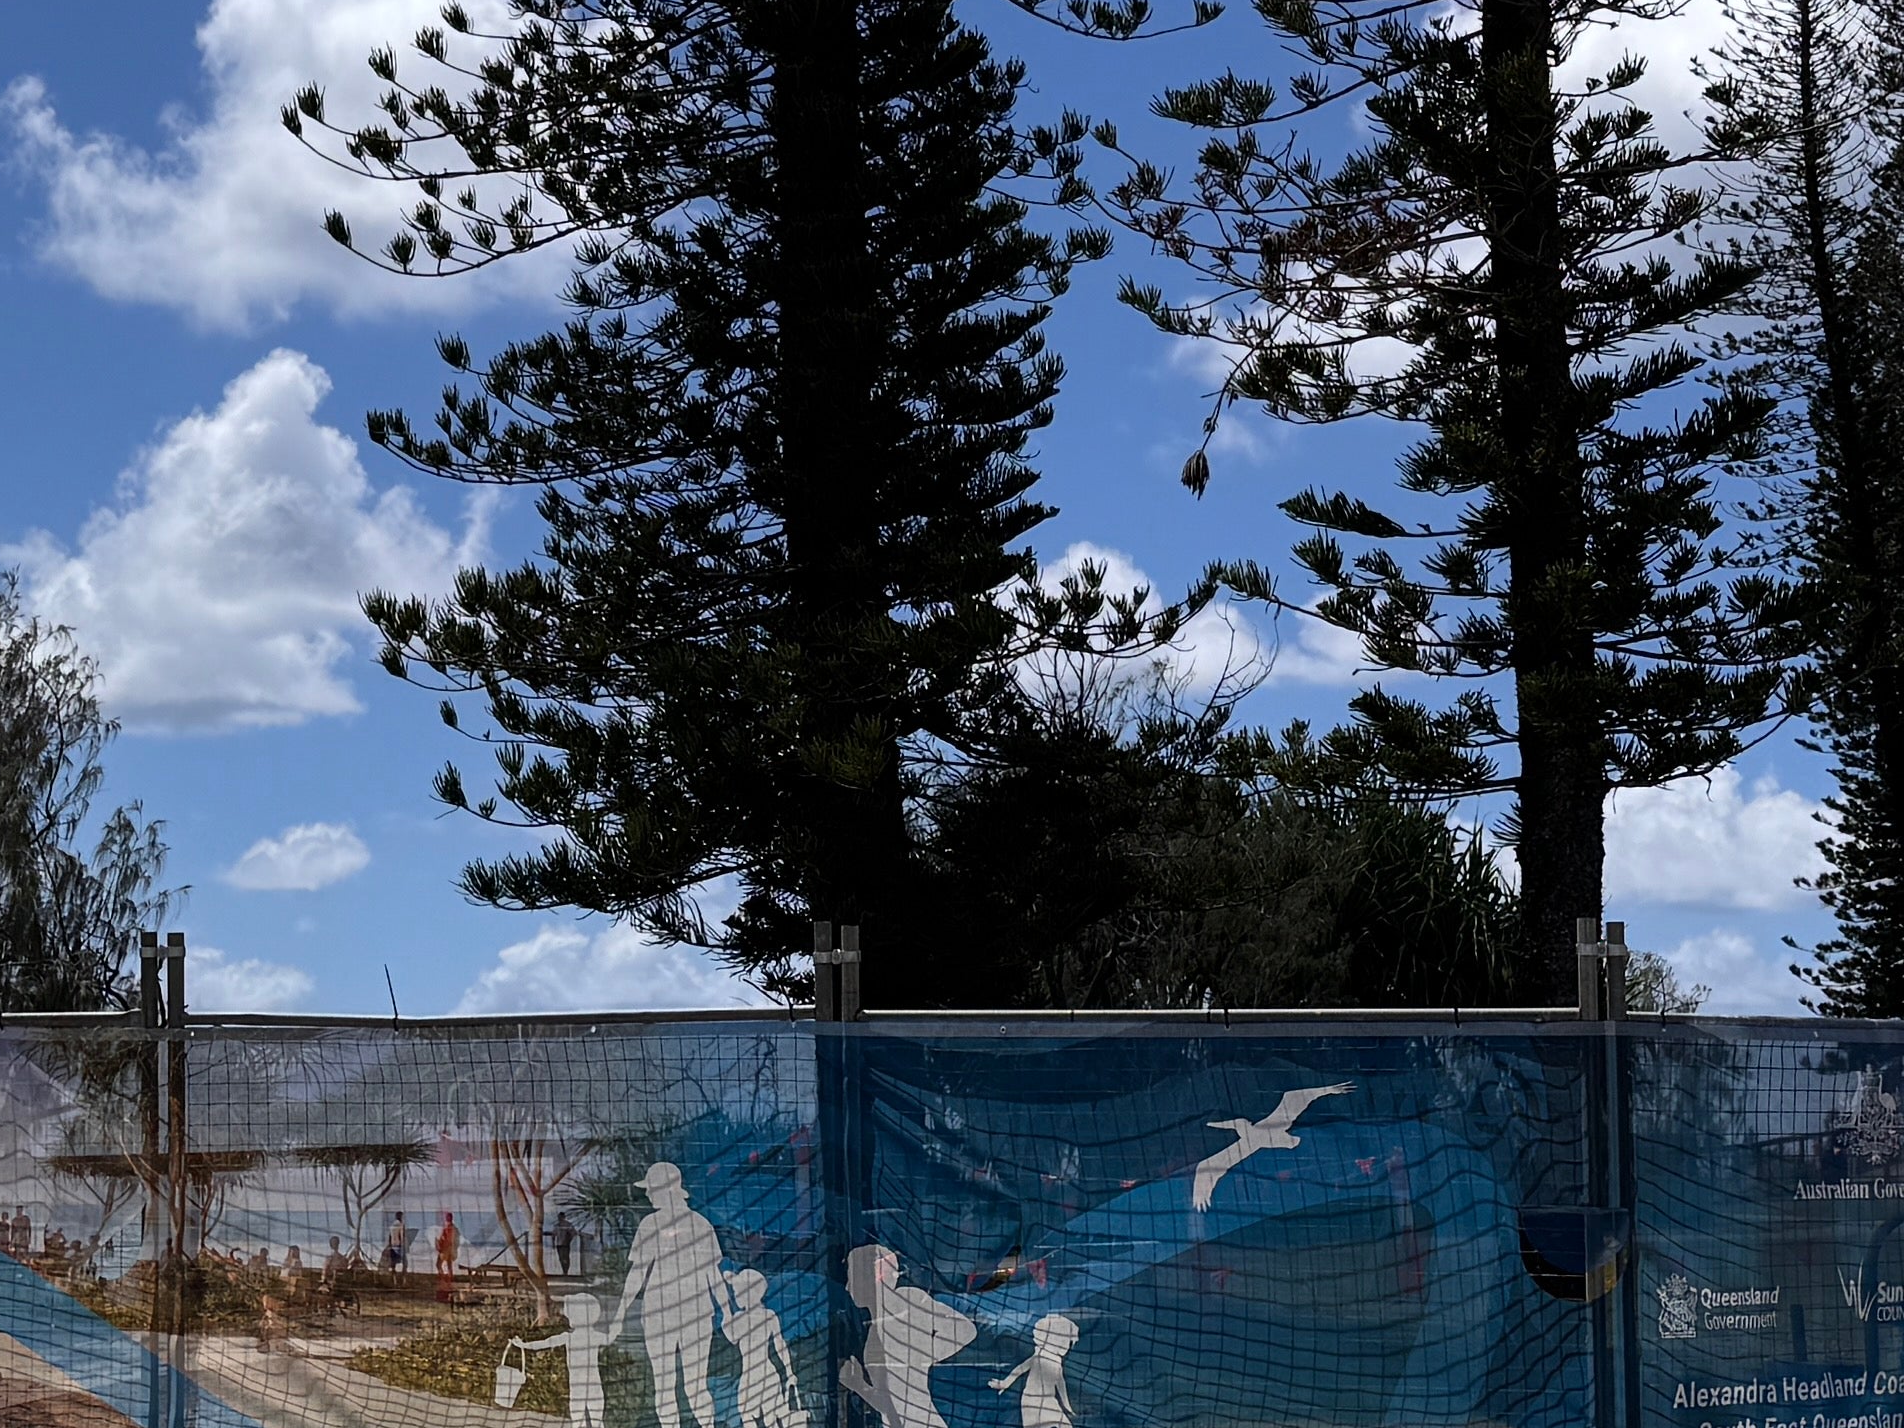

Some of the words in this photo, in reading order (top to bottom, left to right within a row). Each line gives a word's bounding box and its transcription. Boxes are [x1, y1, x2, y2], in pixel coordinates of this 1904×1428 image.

[1793, 1177, 1870, 1200] Australian
[1700, 1285, 1780, 1309] Queensland
[1703, 1311, 1777, 1330] Government
[1672, 1377, 1777, 1409] Alexandra
[1782, 1370, 1868, 1402] Headland
